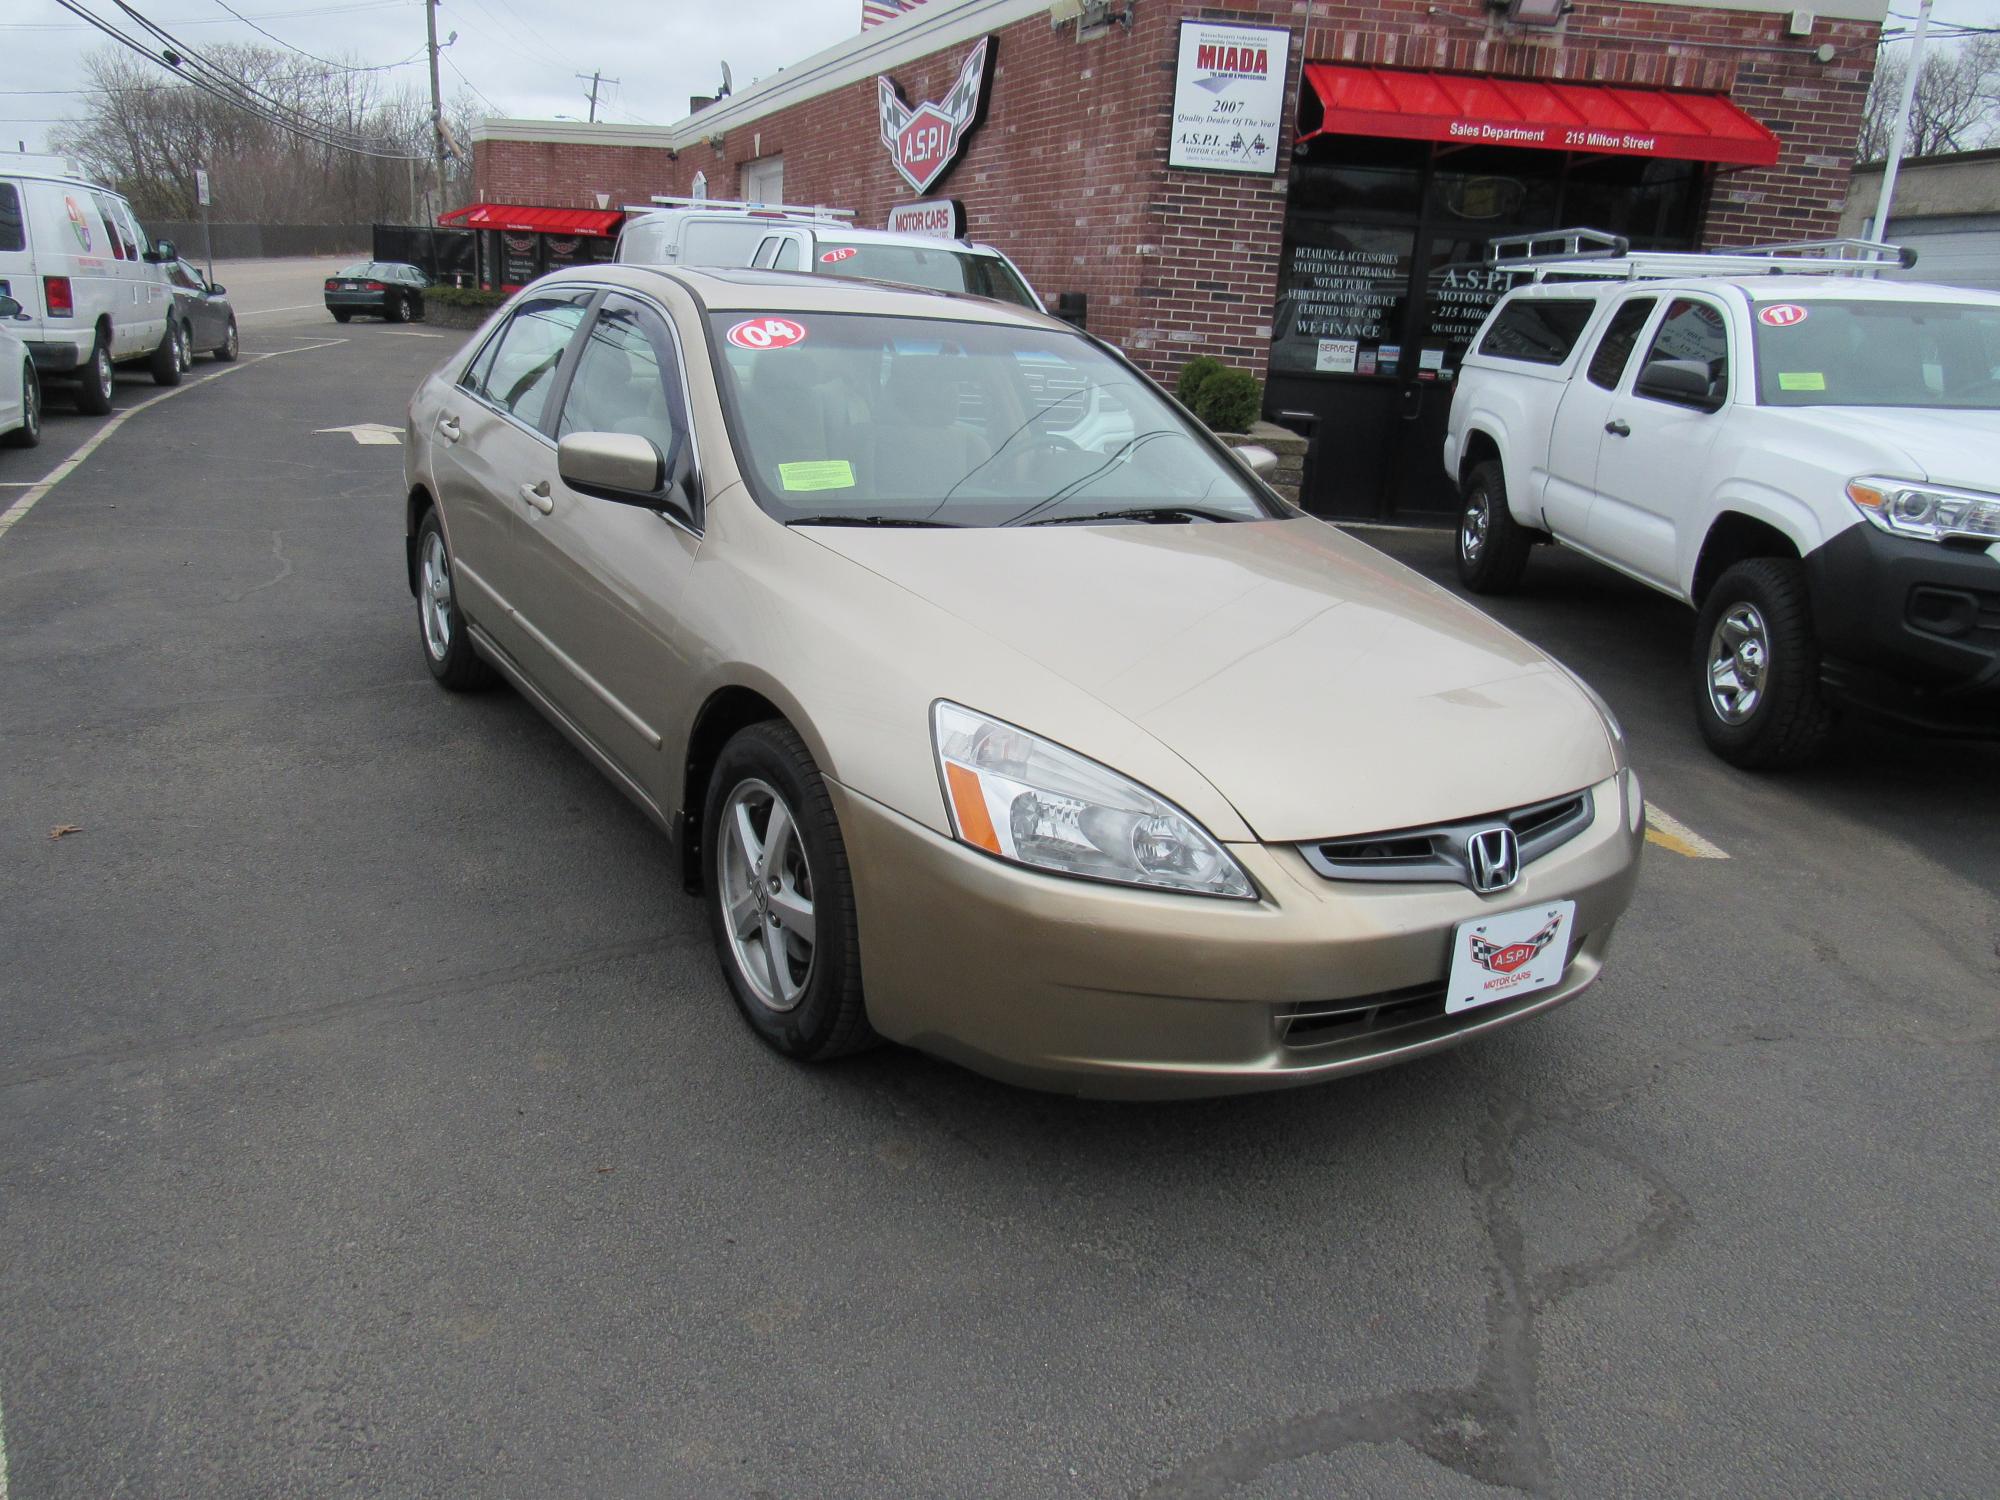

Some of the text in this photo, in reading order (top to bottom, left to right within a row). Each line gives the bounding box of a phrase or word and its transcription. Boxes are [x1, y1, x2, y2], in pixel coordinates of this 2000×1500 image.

[1196, 44, 1268, 74] MIADA
[1212, 99, 1245, 113] 2007
[1177, 113, 1276, 128] Quality Dealer Of The Year
[1177, 133, 1221, 147] A.S.P.I.
[1450, 122, 1654, 151] Sales Department 215 Milton Street
[895, 208, 949, 232] MOTOR CARS
[832, 250, 847, 262] 18
[1295, 247, 1399, 265] DETAILING & ACCESSORIES
[1292, 261, 1397, 279] STATED VALUE APPRAISALS
[1313, 276, 1375, 290] NOTARY PUBLIC
[1288, 288, 1397, 307] VEHICLE LOCATING SERVICE
[1436, 290, 1484, 304] MOTOR
[1298, 303, 1382, 320] CERTIFIED USED CARS
[1439, 306, 1459, 318] 215
[1460, 308, 1489, 320] Milto
[1769, 306, 1795, 324] 17
[742, 320, 795, 346] 04
[1296, 320, 1381, 338] WE FINANCE
[1431, 323, 1468, 334] QUALITY
[1319, 343, 1355, 354] SERVICE
[1483, 975, 1510, 990] MOTOR
[1511, 970, 1531, 983] CARS
